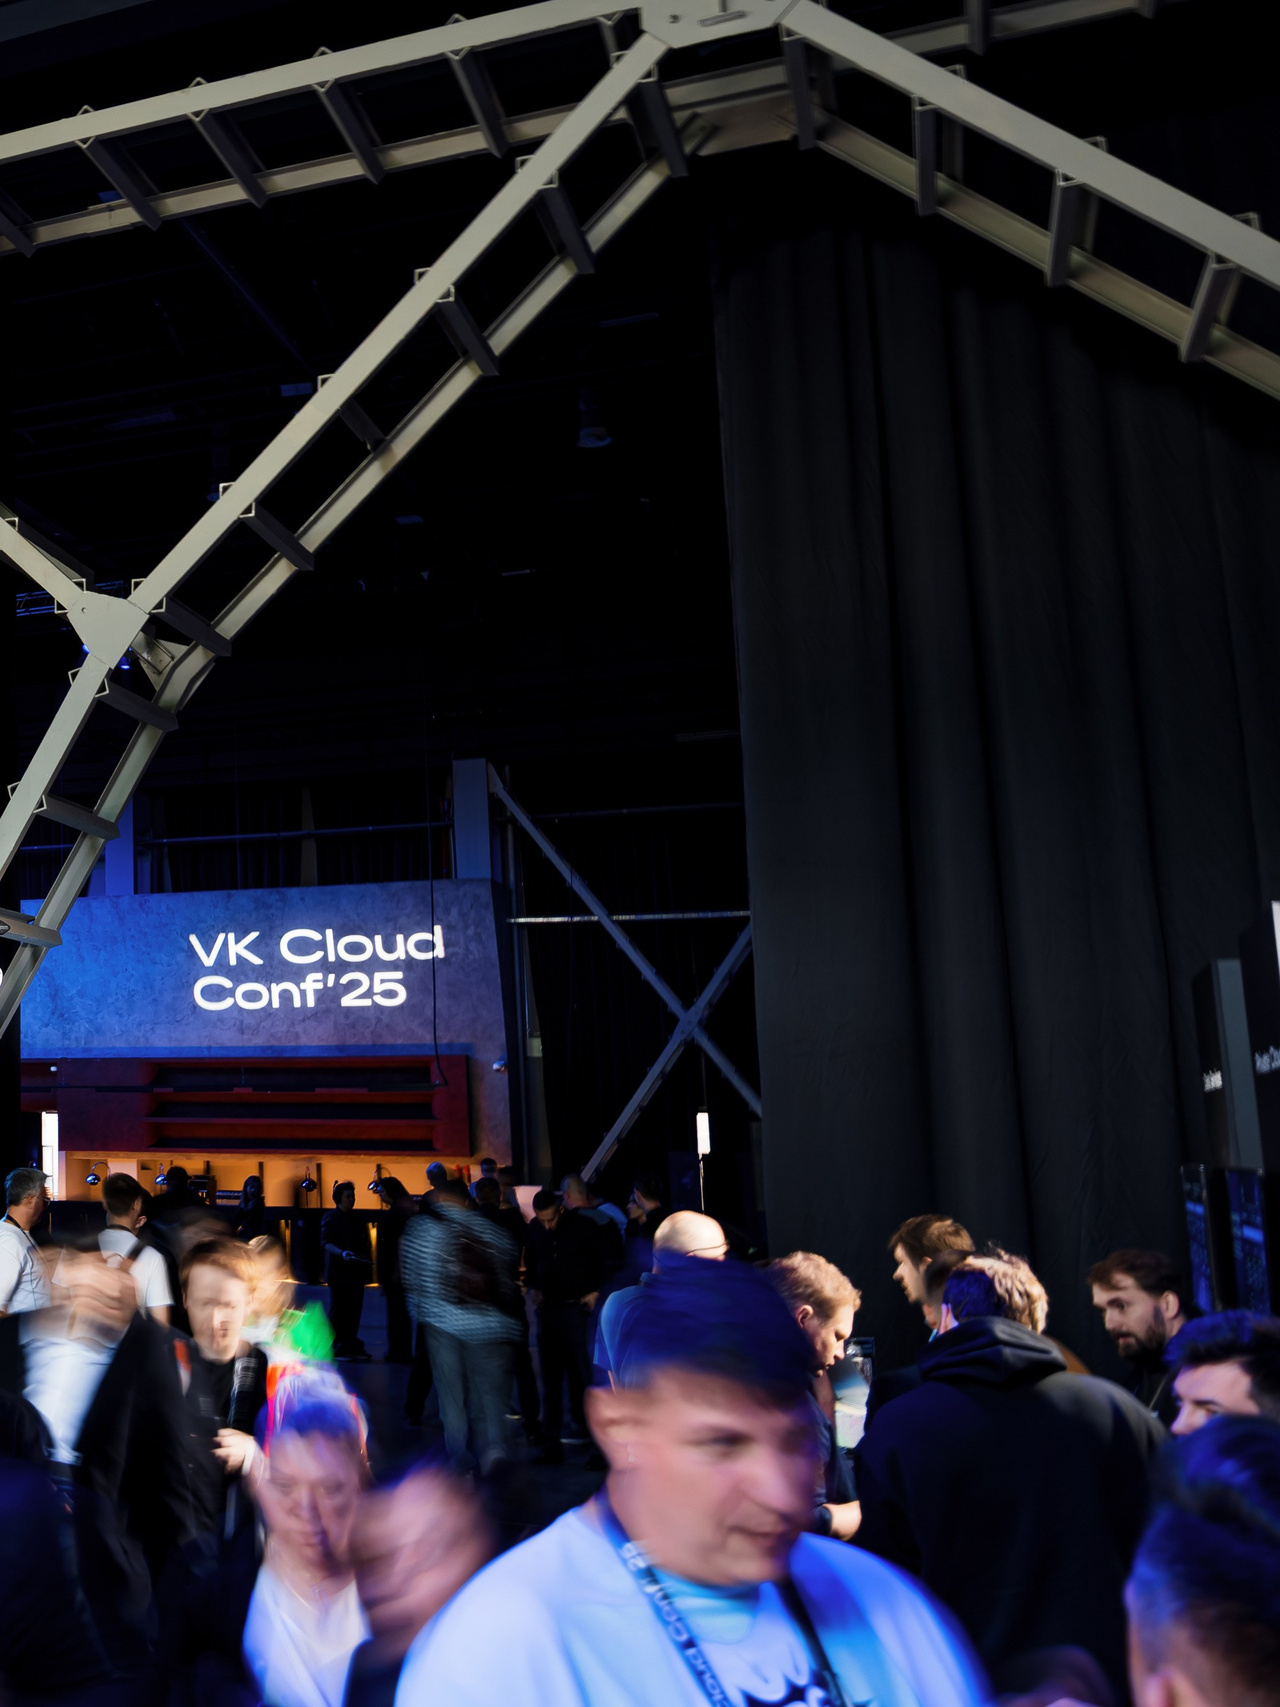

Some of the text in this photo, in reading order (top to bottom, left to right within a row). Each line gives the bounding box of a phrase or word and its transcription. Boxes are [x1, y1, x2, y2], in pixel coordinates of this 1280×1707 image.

[189, 925, 446, 967] VK Cloud
[193, 971, 407, 1011] Conf'25
